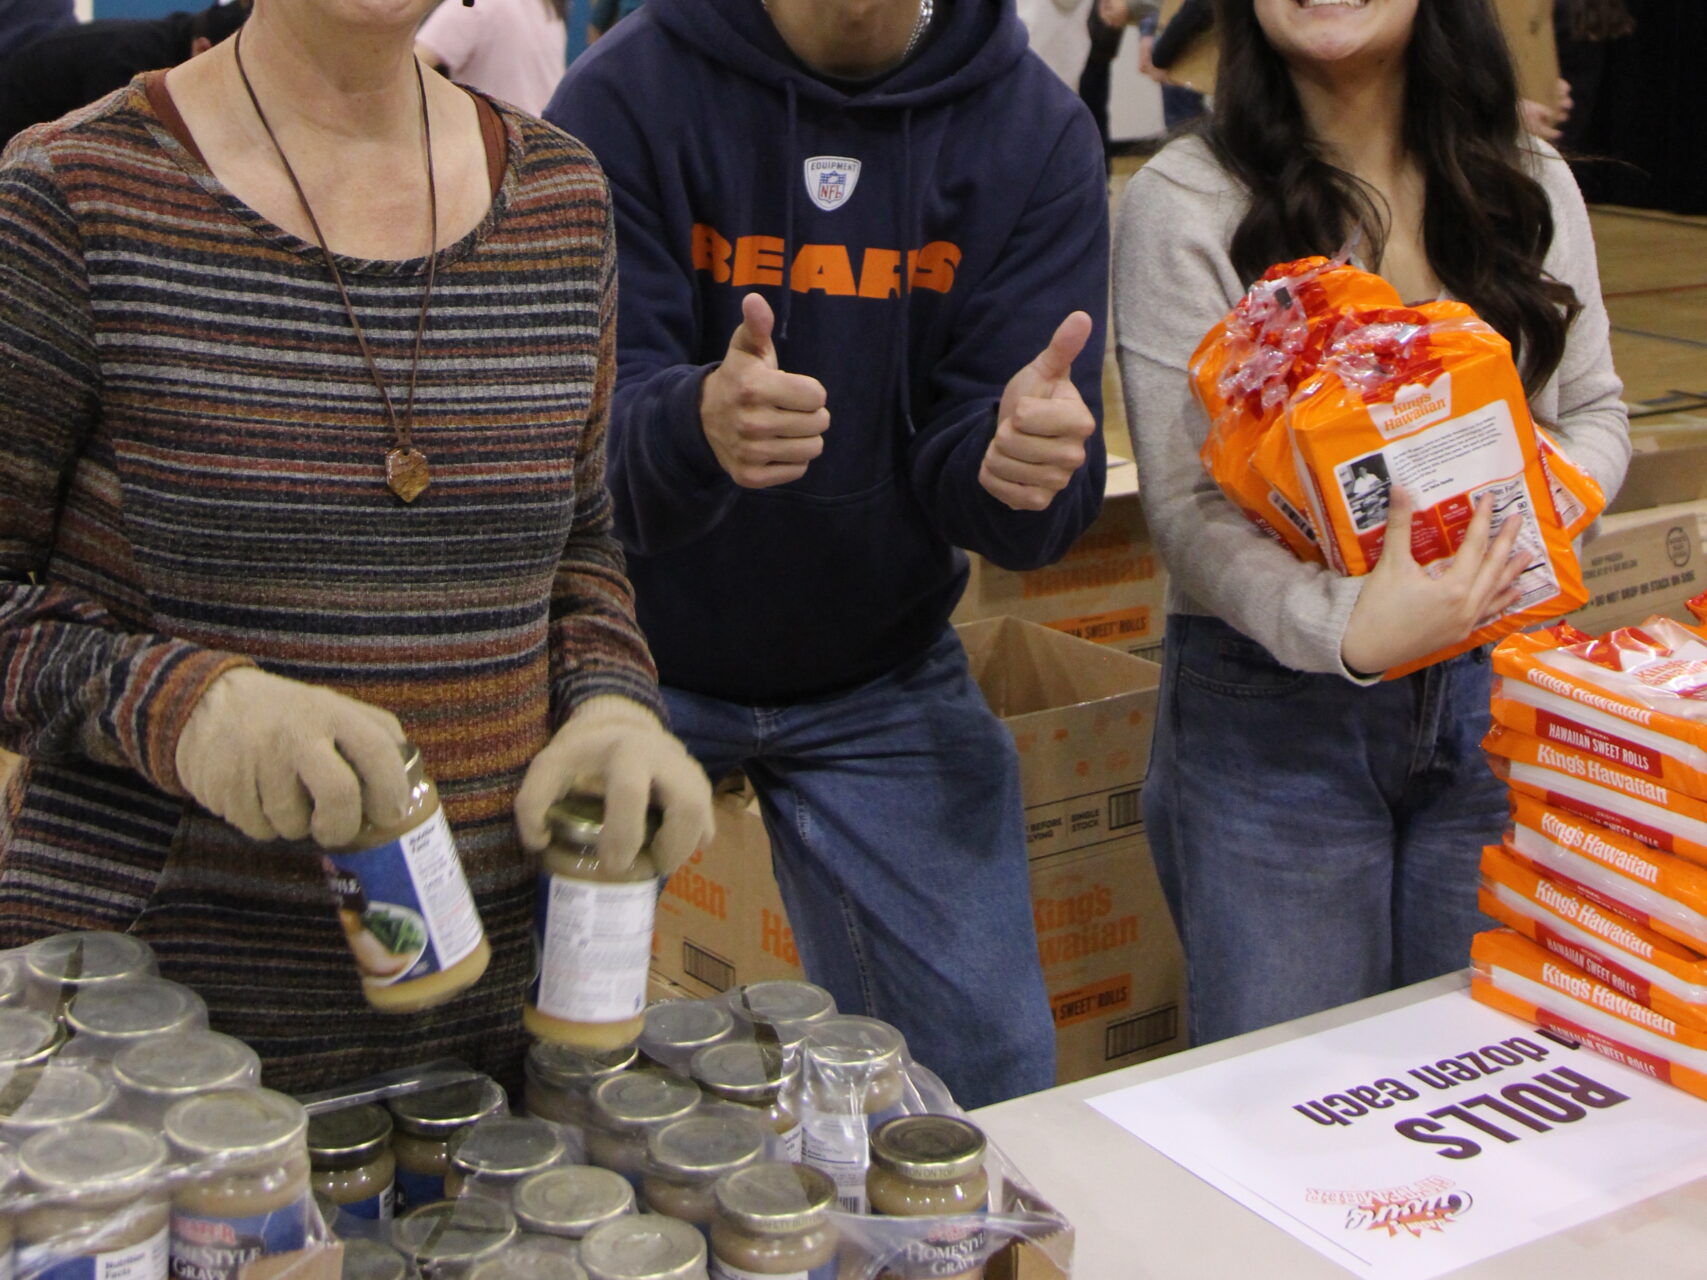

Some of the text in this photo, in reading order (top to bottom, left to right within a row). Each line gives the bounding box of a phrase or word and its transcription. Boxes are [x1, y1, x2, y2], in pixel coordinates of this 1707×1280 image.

[811, 161, 857, 172] EQUIPMENT
[820, 184, 843, 200] NFL
[691, 222, 962, 300] BEARS
[1384, 400, 1447, 432] Hawaiian
[1392, 393, 1432, 416] King's
[1548, 723, 1650, 771] HAWAIIAN SWEET ROLLS
[1537, 743, 1669, 806] King's Hawaiian
[1541, 811, 1660, 884] King's Hawaiian
[1038, 914, 1139, 967] waiian
[1535, 879, 1580, 919] King's
[1578, 902, 1654, 960] Hawaiian
[1546, 937, 1638, 1000] HAWAIIAN SWEET ROLLS
[1097, 986, 1128, 1008] ROLLS
[1542, 962, 1677, 1037] King's Hawaiian
[1407, 1036, 1551, 1090] dozen
[1291, 1077, 1420, 1127] each
[1394, 1065, 1632, 1160] ROLLS
[1344, 1189, 1474, 1231] Giving
[907, 1231, 987, 1262] HOMESTYL
